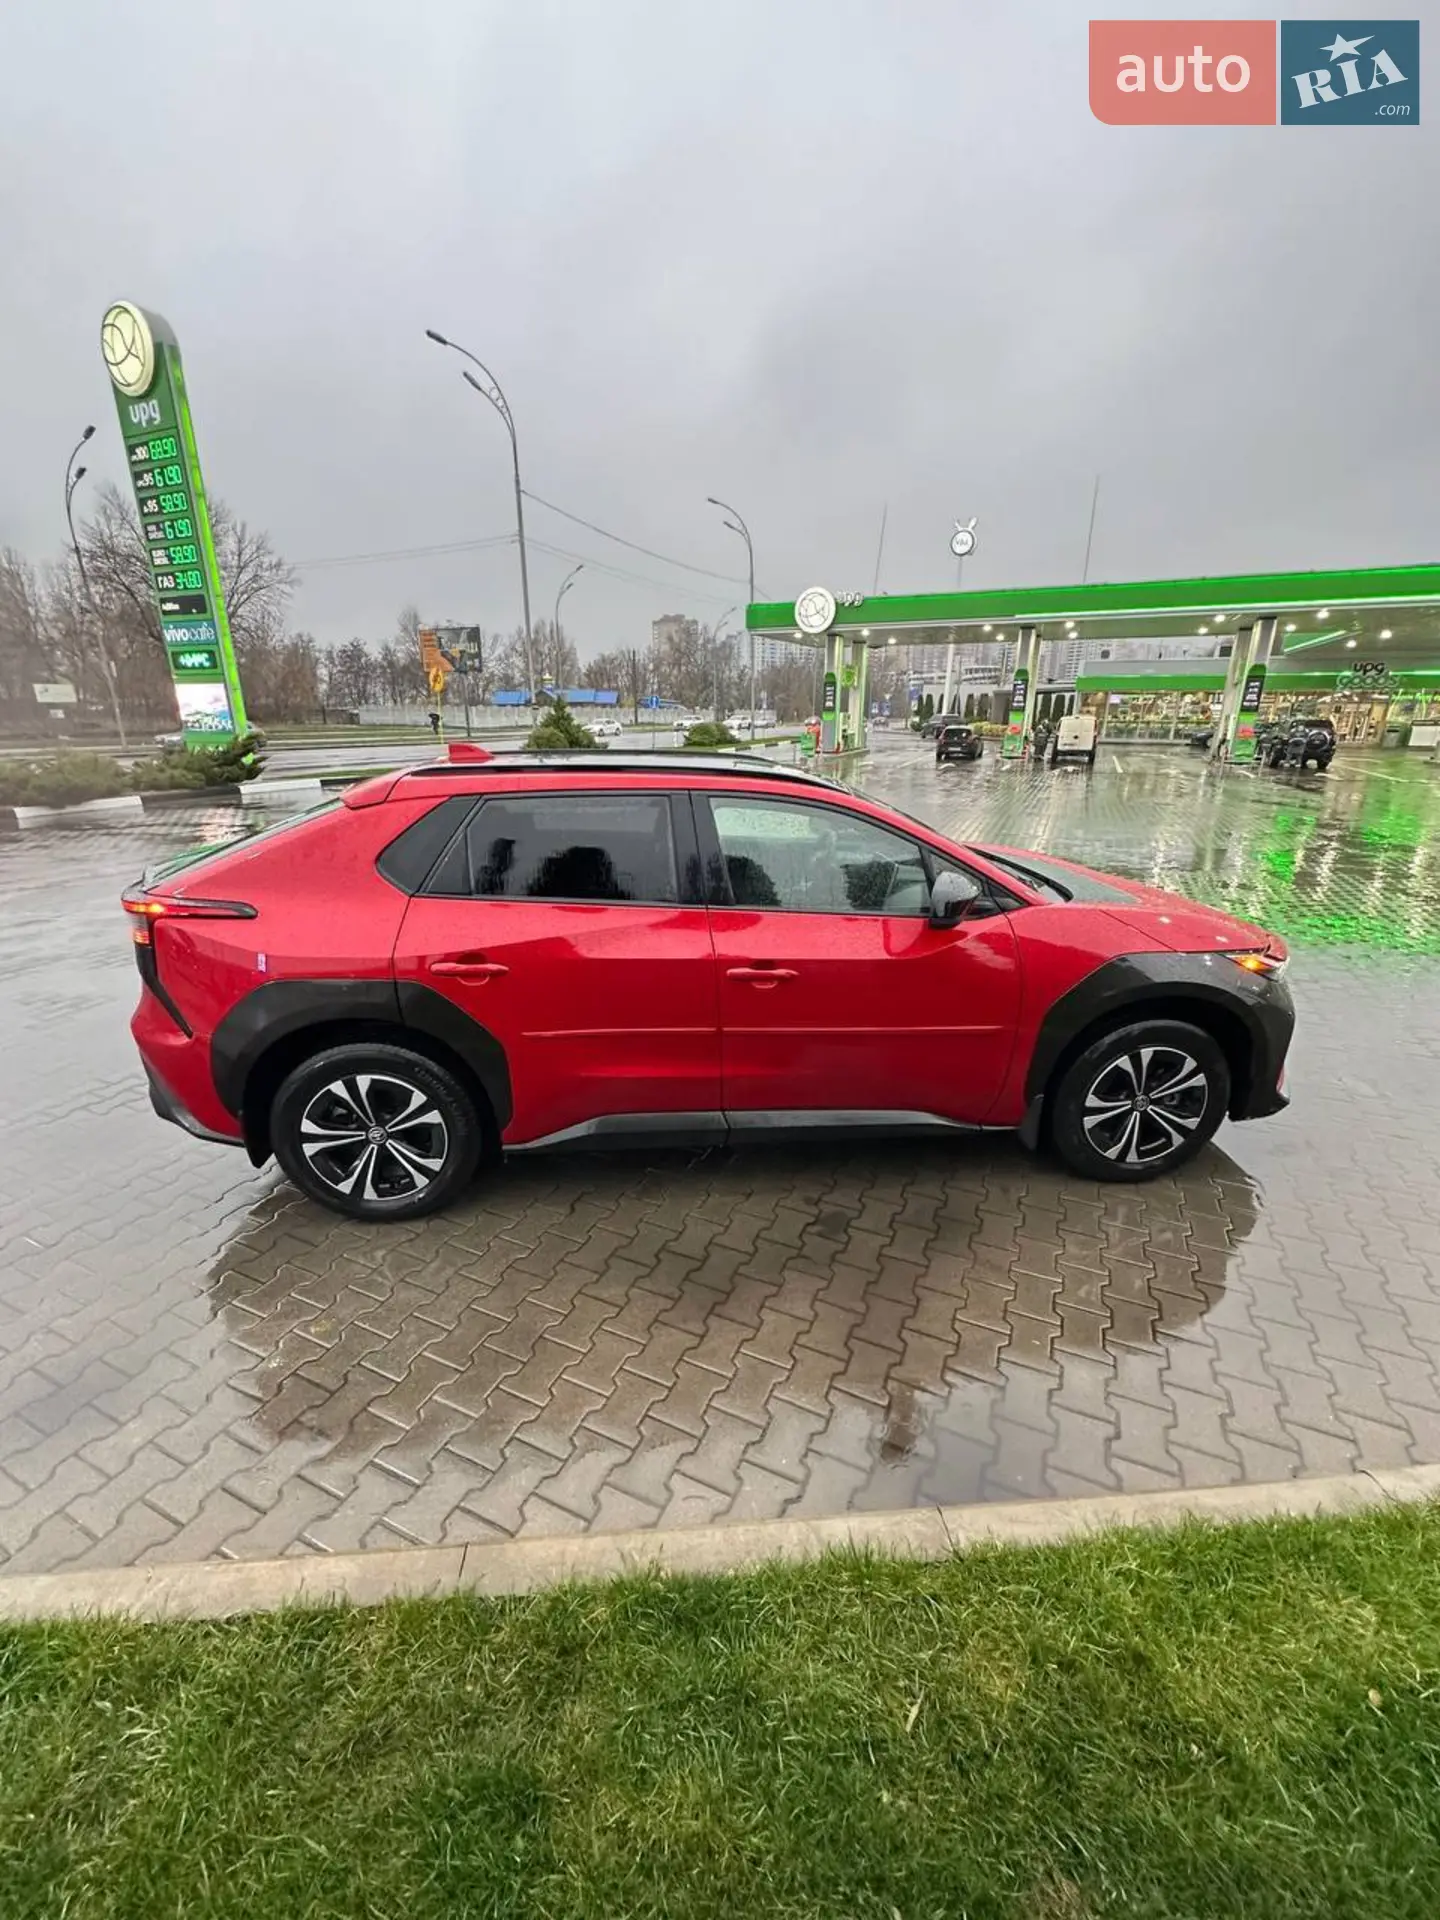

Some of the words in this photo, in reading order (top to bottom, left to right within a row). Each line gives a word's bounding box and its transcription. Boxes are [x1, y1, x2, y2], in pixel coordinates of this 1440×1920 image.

[128, 399, 161, 427] upg
[157, 575, 175, 589] ГАЗ
[1353, 662, 1385, 676] upg
